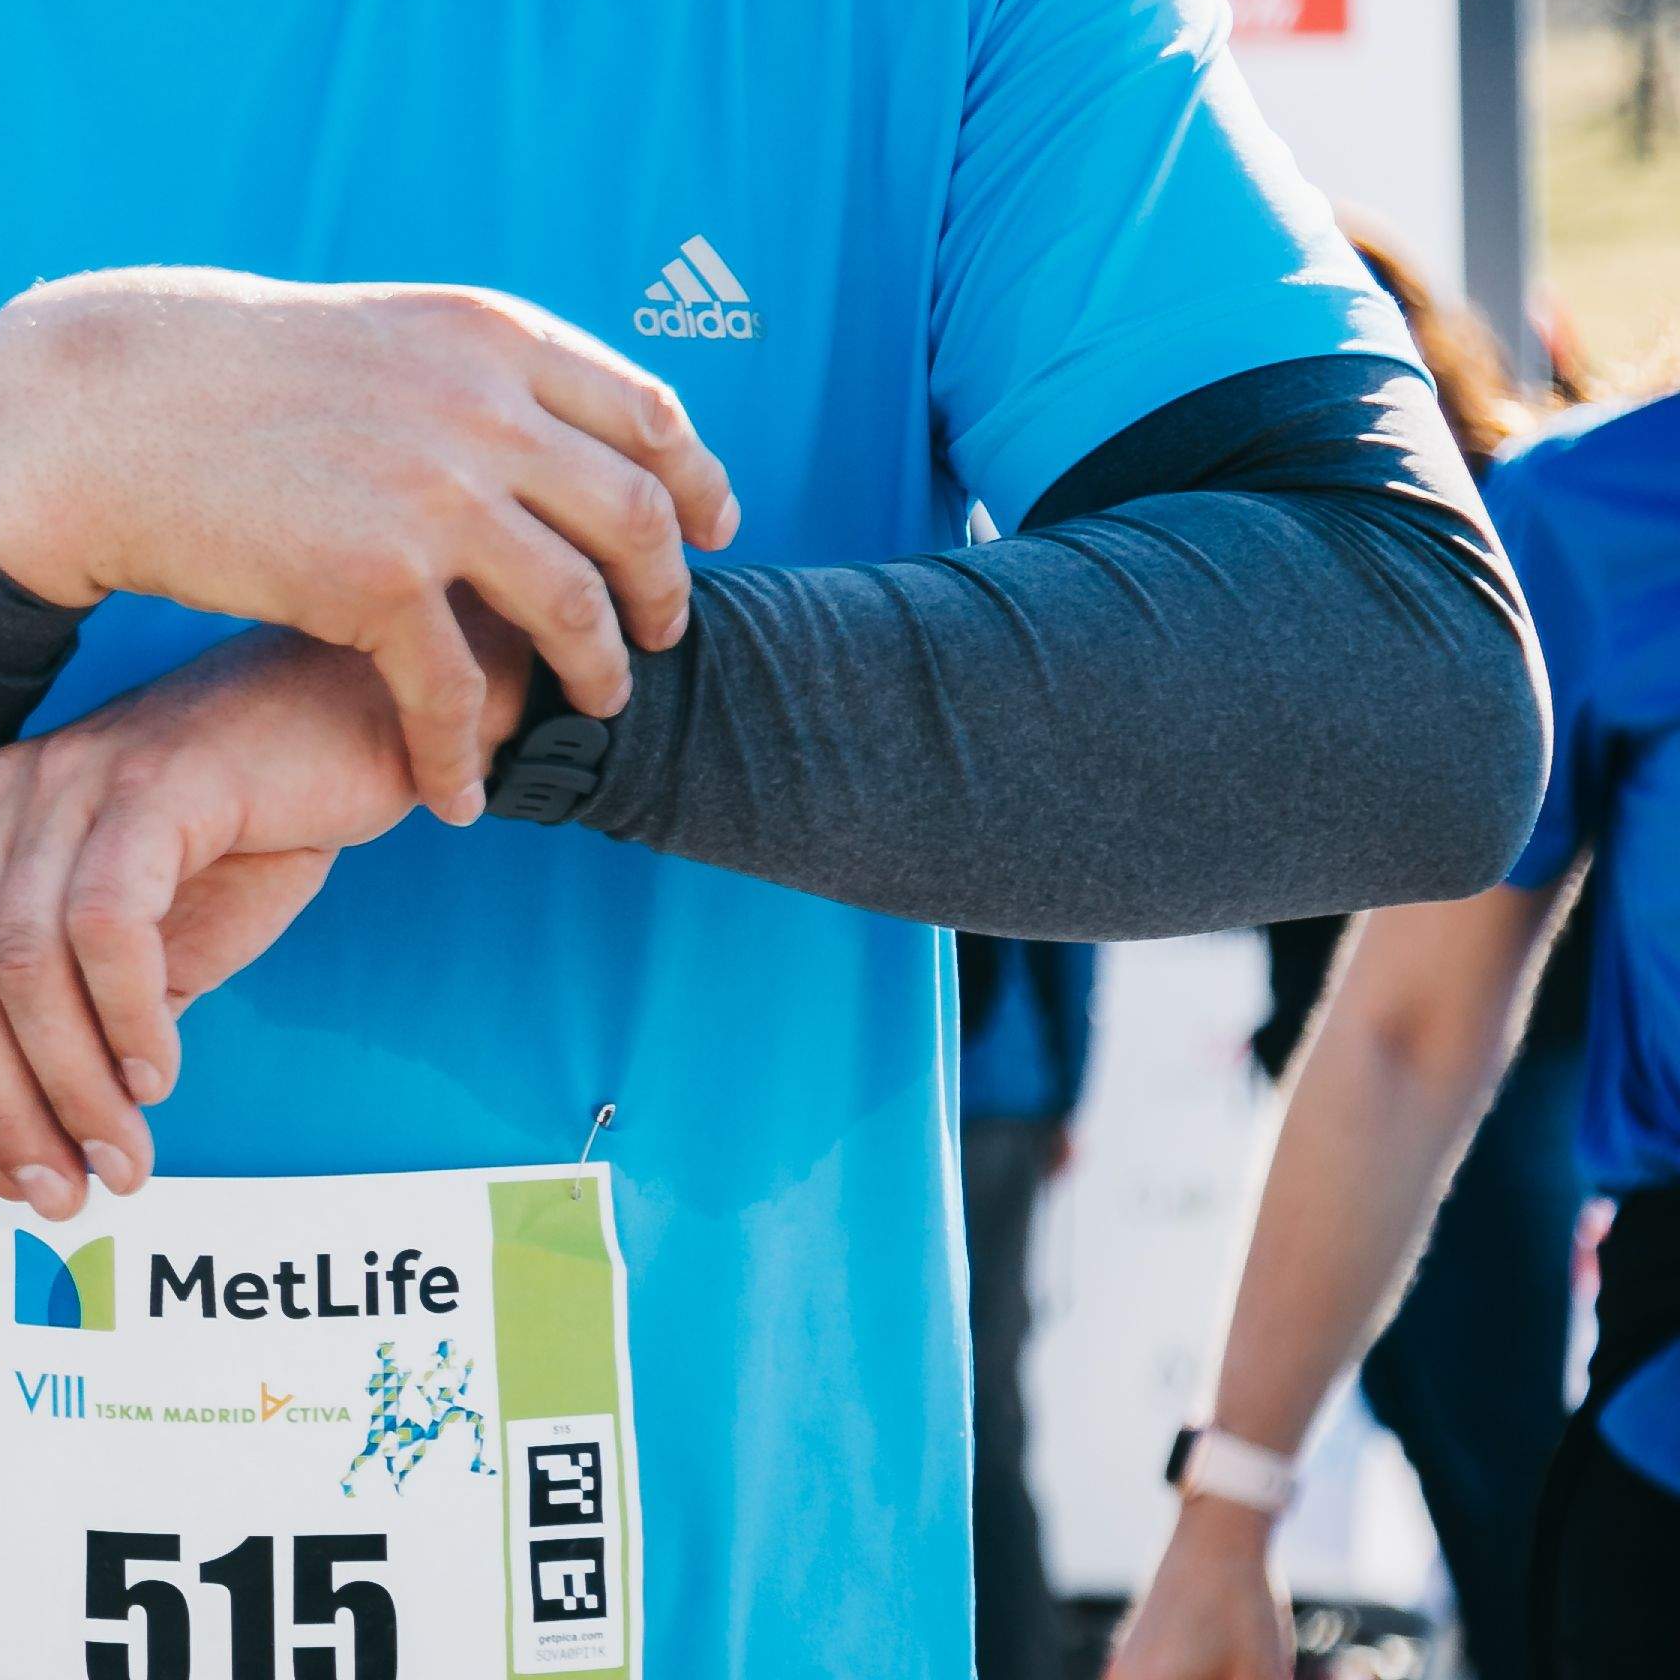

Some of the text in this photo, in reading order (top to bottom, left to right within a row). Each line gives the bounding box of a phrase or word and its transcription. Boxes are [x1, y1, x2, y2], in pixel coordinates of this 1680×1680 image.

[149, 1249, 460, 1319] MetLife
[15, 1371, 85, 1419] VIII
[95, 1404, 152, 1421] 15KM
[85, 1530, 397, 1680] 515
